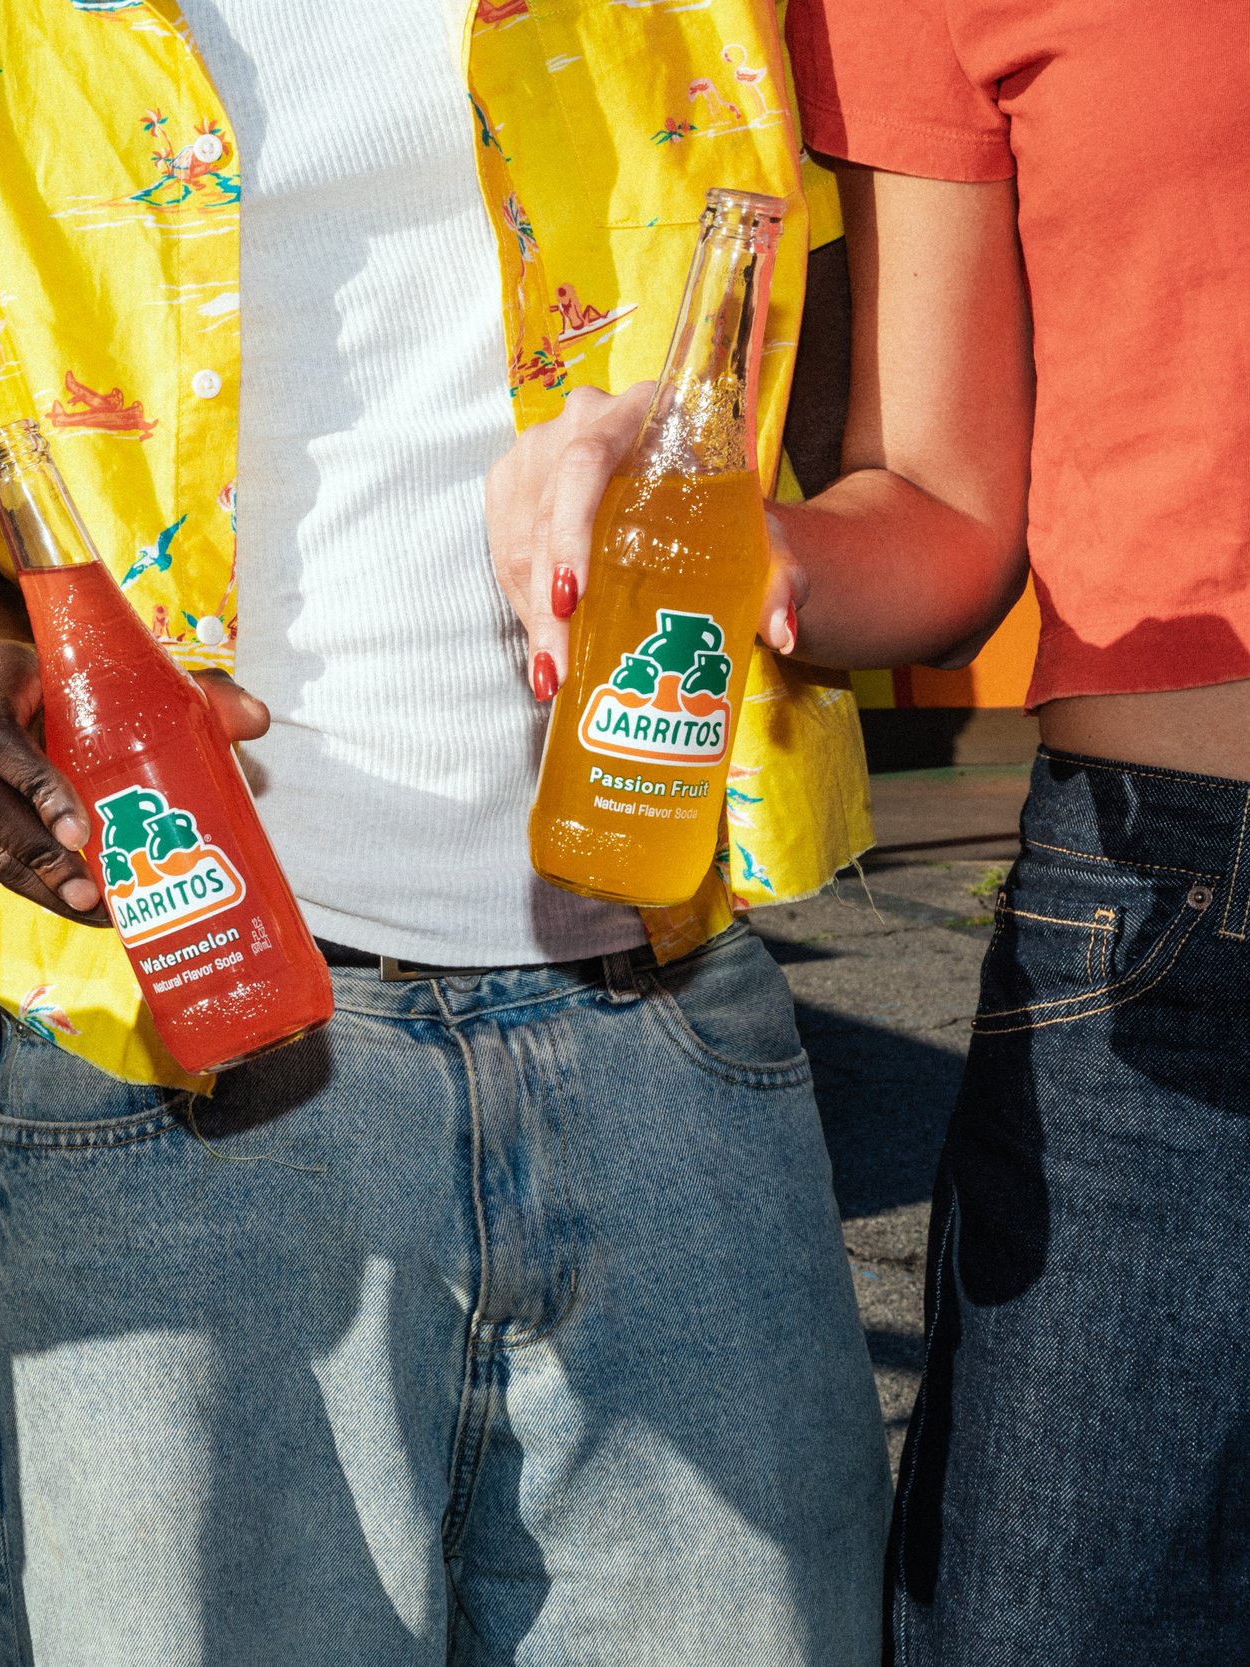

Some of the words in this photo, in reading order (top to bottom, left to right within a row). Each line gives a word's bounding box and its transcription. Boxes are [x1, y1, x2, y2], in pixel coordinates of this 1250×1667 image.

[595, 707, 723, 748] JARRITOS
[589, 765, 666, 796] Passion
[670, 779, 711, 799] Fruit
[593, 795, 636, 816] Natural
[637, 803, 673, 819] Flavor
[674, 806, 699, 820] Soda
[117, 868, 224, 930] JARRITOS
[139, 926, 241, 976] Watermelon
[152, 973, 184, 995] Natural
[182, 962, 214, 985] Flavor
[214, 951, 244, 971] Soda
